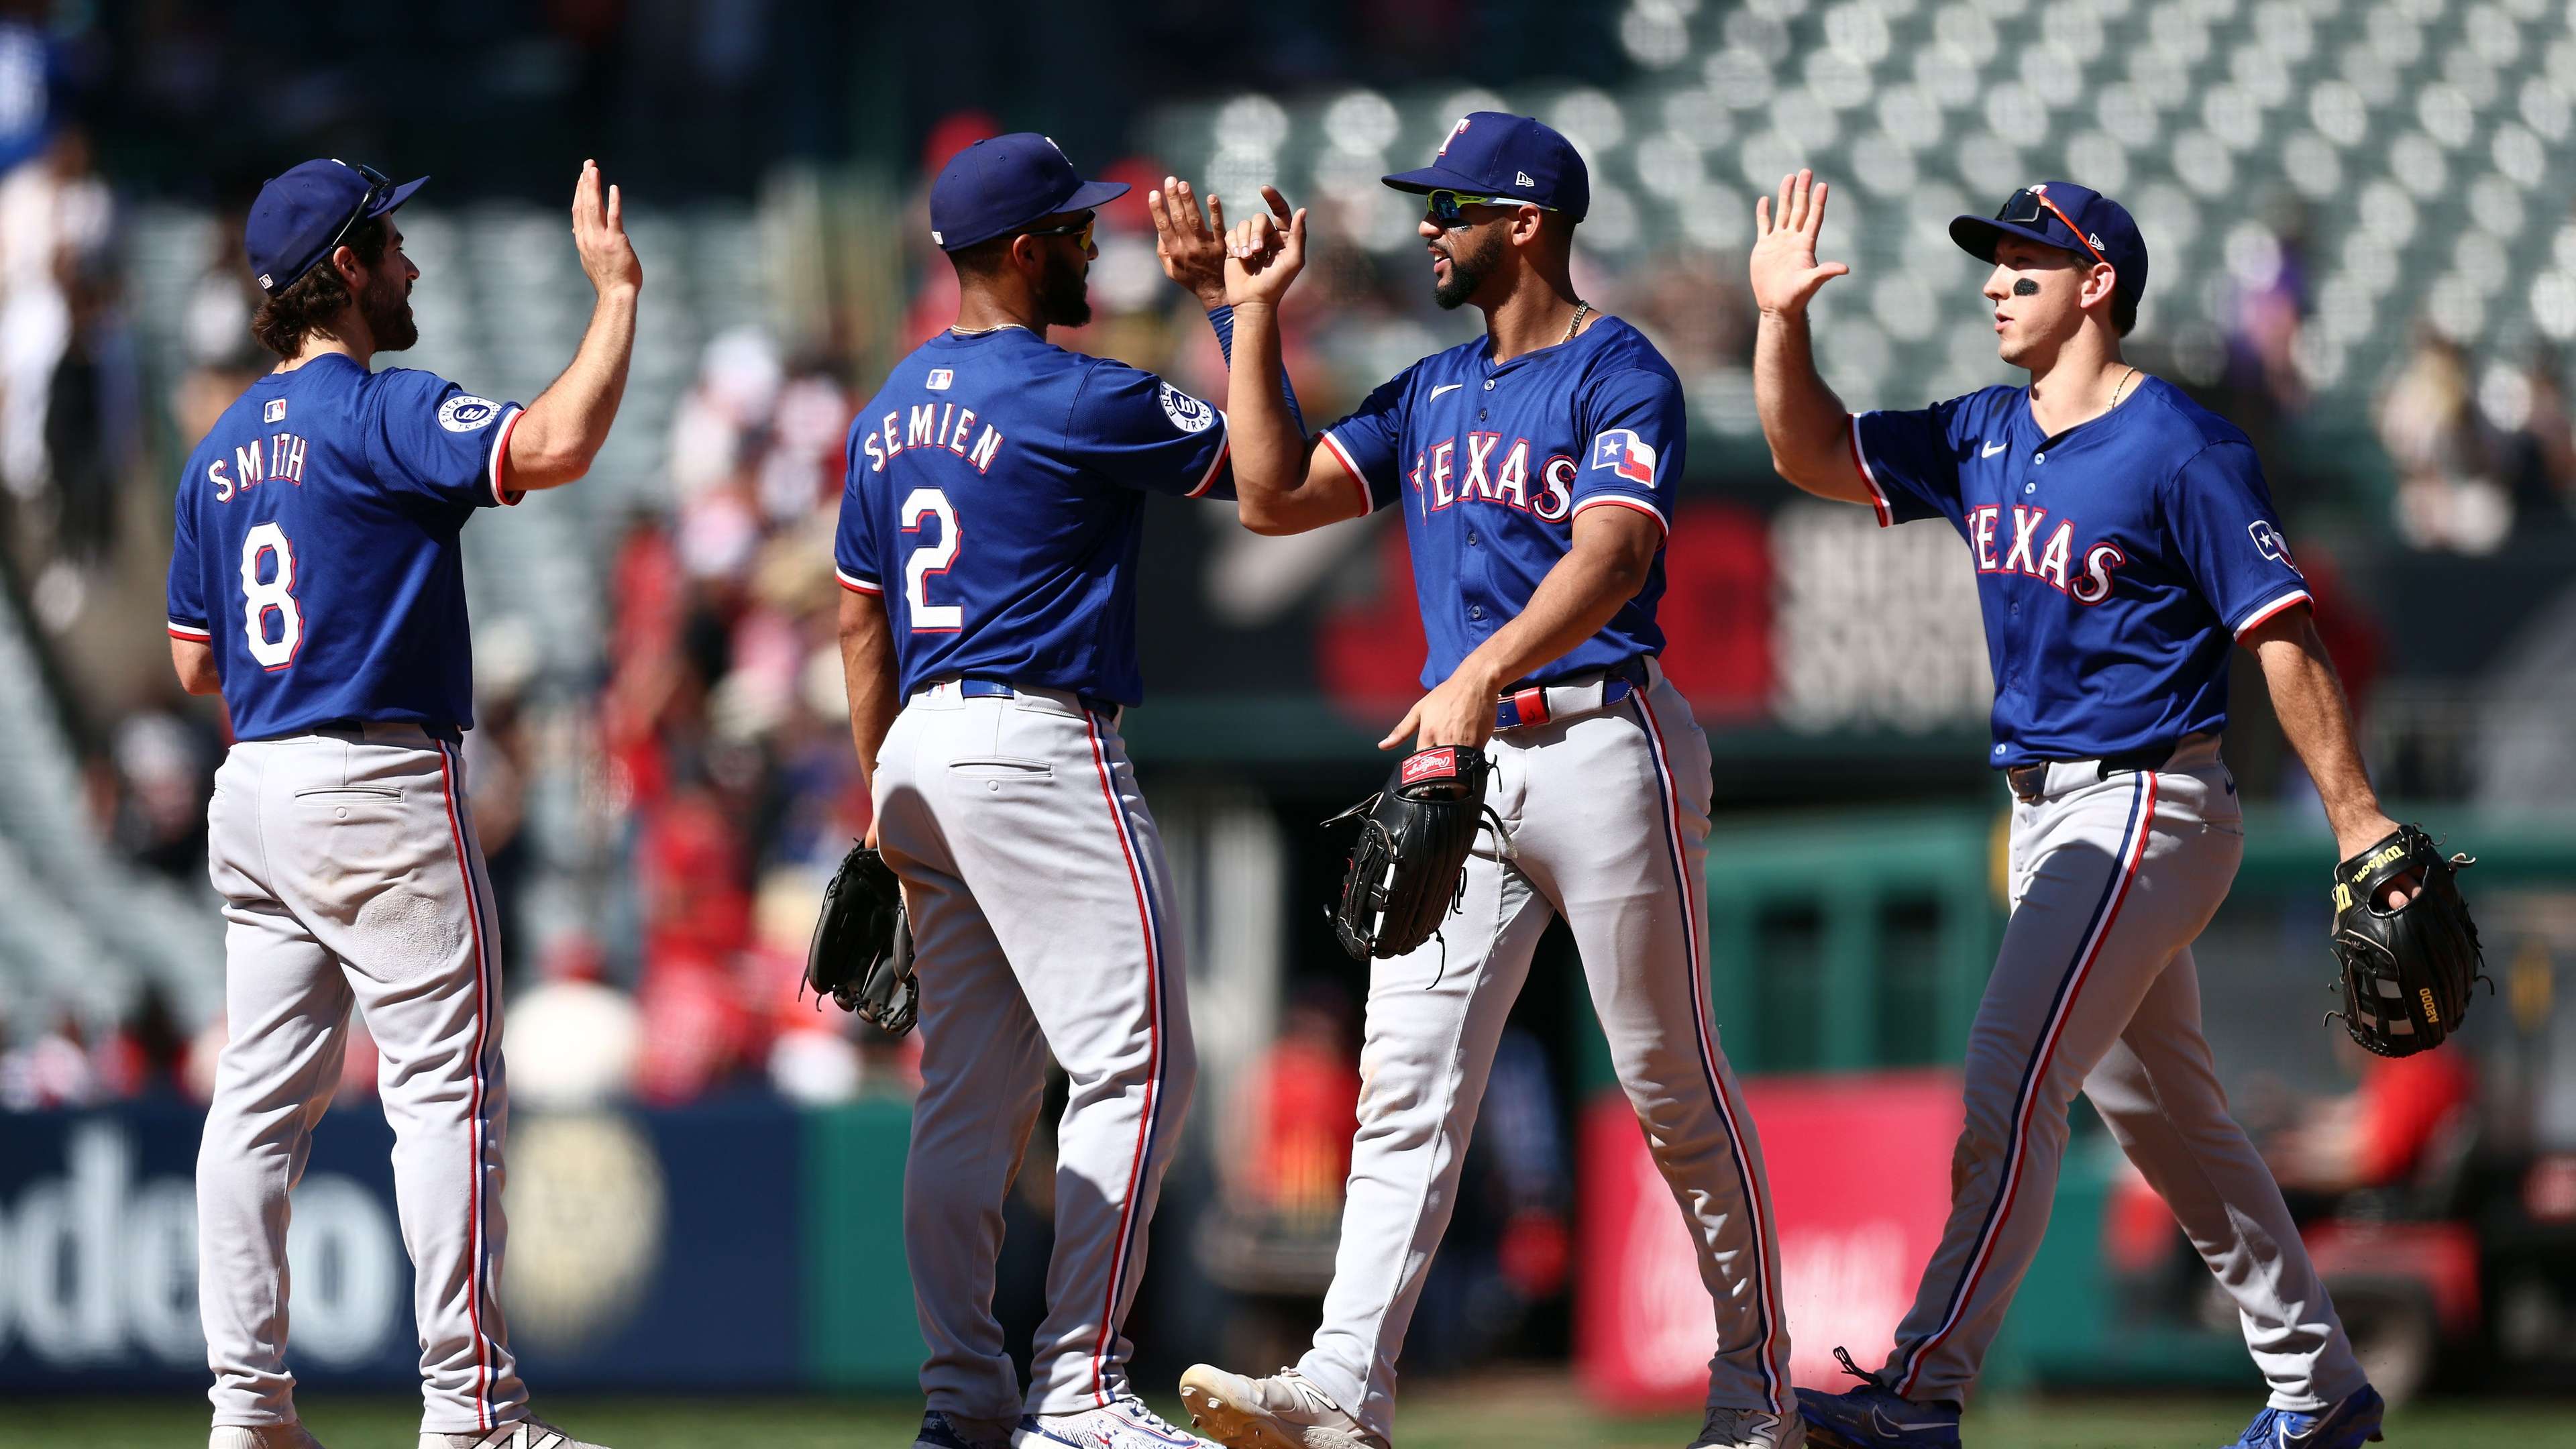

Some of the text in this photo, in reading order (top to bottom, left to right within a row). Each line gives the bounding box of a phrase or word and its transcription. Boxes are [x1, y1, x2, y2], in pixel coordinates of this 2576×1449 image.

[441, 397, 483, 423] ENERGY
[864, 402, 1004, 474] SEMIEN
[208, 431, 308, 504] SMITH
[1407, 431, 1578, 526] TEXAS
[900, 486, 963, 633] 2
[240, 521, 305, 672] 8
[2355, 845, 2405, 883] Wilson
[2419, 987, 2440, 1024] A2000
[0, 1124, 401, 1374] deo
